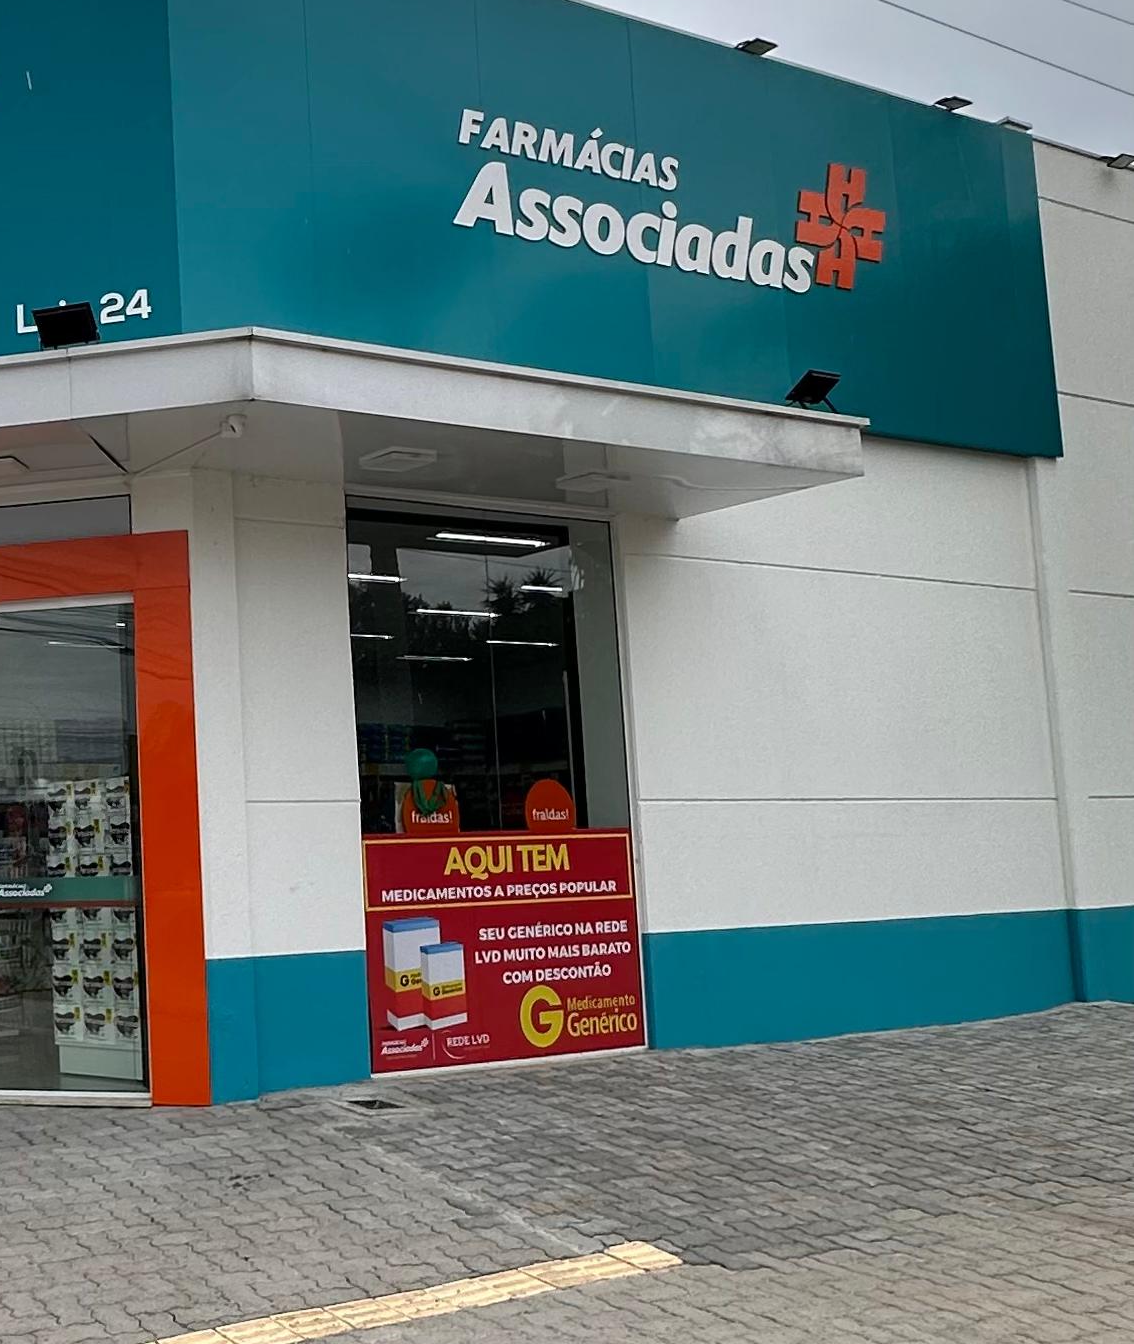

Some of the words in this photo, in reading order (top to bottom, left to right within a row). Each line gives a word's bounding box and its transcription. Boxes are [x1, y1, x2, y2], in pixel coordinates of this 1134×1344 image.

[458, 108, 679, 191] FARMÁCIAS
[453, 161, 815, 293] Associadas
[100, 288, 152, 325] 24
[532, 808, 569, 821] fraldas!
[444, 845, 513, 880] AQUI
[516, 843, 570, 874] TEM
[381, 886, 493, 903] MEDICAMENTOS
[494, 884, 506, 897] A
[507, 882, 558, 899] PREÇOS
[559, 880, 617, 894] POPULAR
[478, 927, 506, 941] SEU
[507, 921, 574, 940] GENÉRICO
[574, 923, 594, 936] NA
[595, 919, 629, 934] REDE
[474, 950, 502, 965] LVD
[503, 946, 547, 963] MUITO
[547, 944, 581, 960] MAIS
[582, 940, 632, 957] BARATO
[502, 969, 534, 985] COM
[535, 962, 612, 983] DESCONTÃO
[566, 994, 637, 1012] Medicamento
[519, 985, 565, 1048] G
[566, 1007, 638, 1038] Genérico
[471, 1034, 491, 1045] LVD
